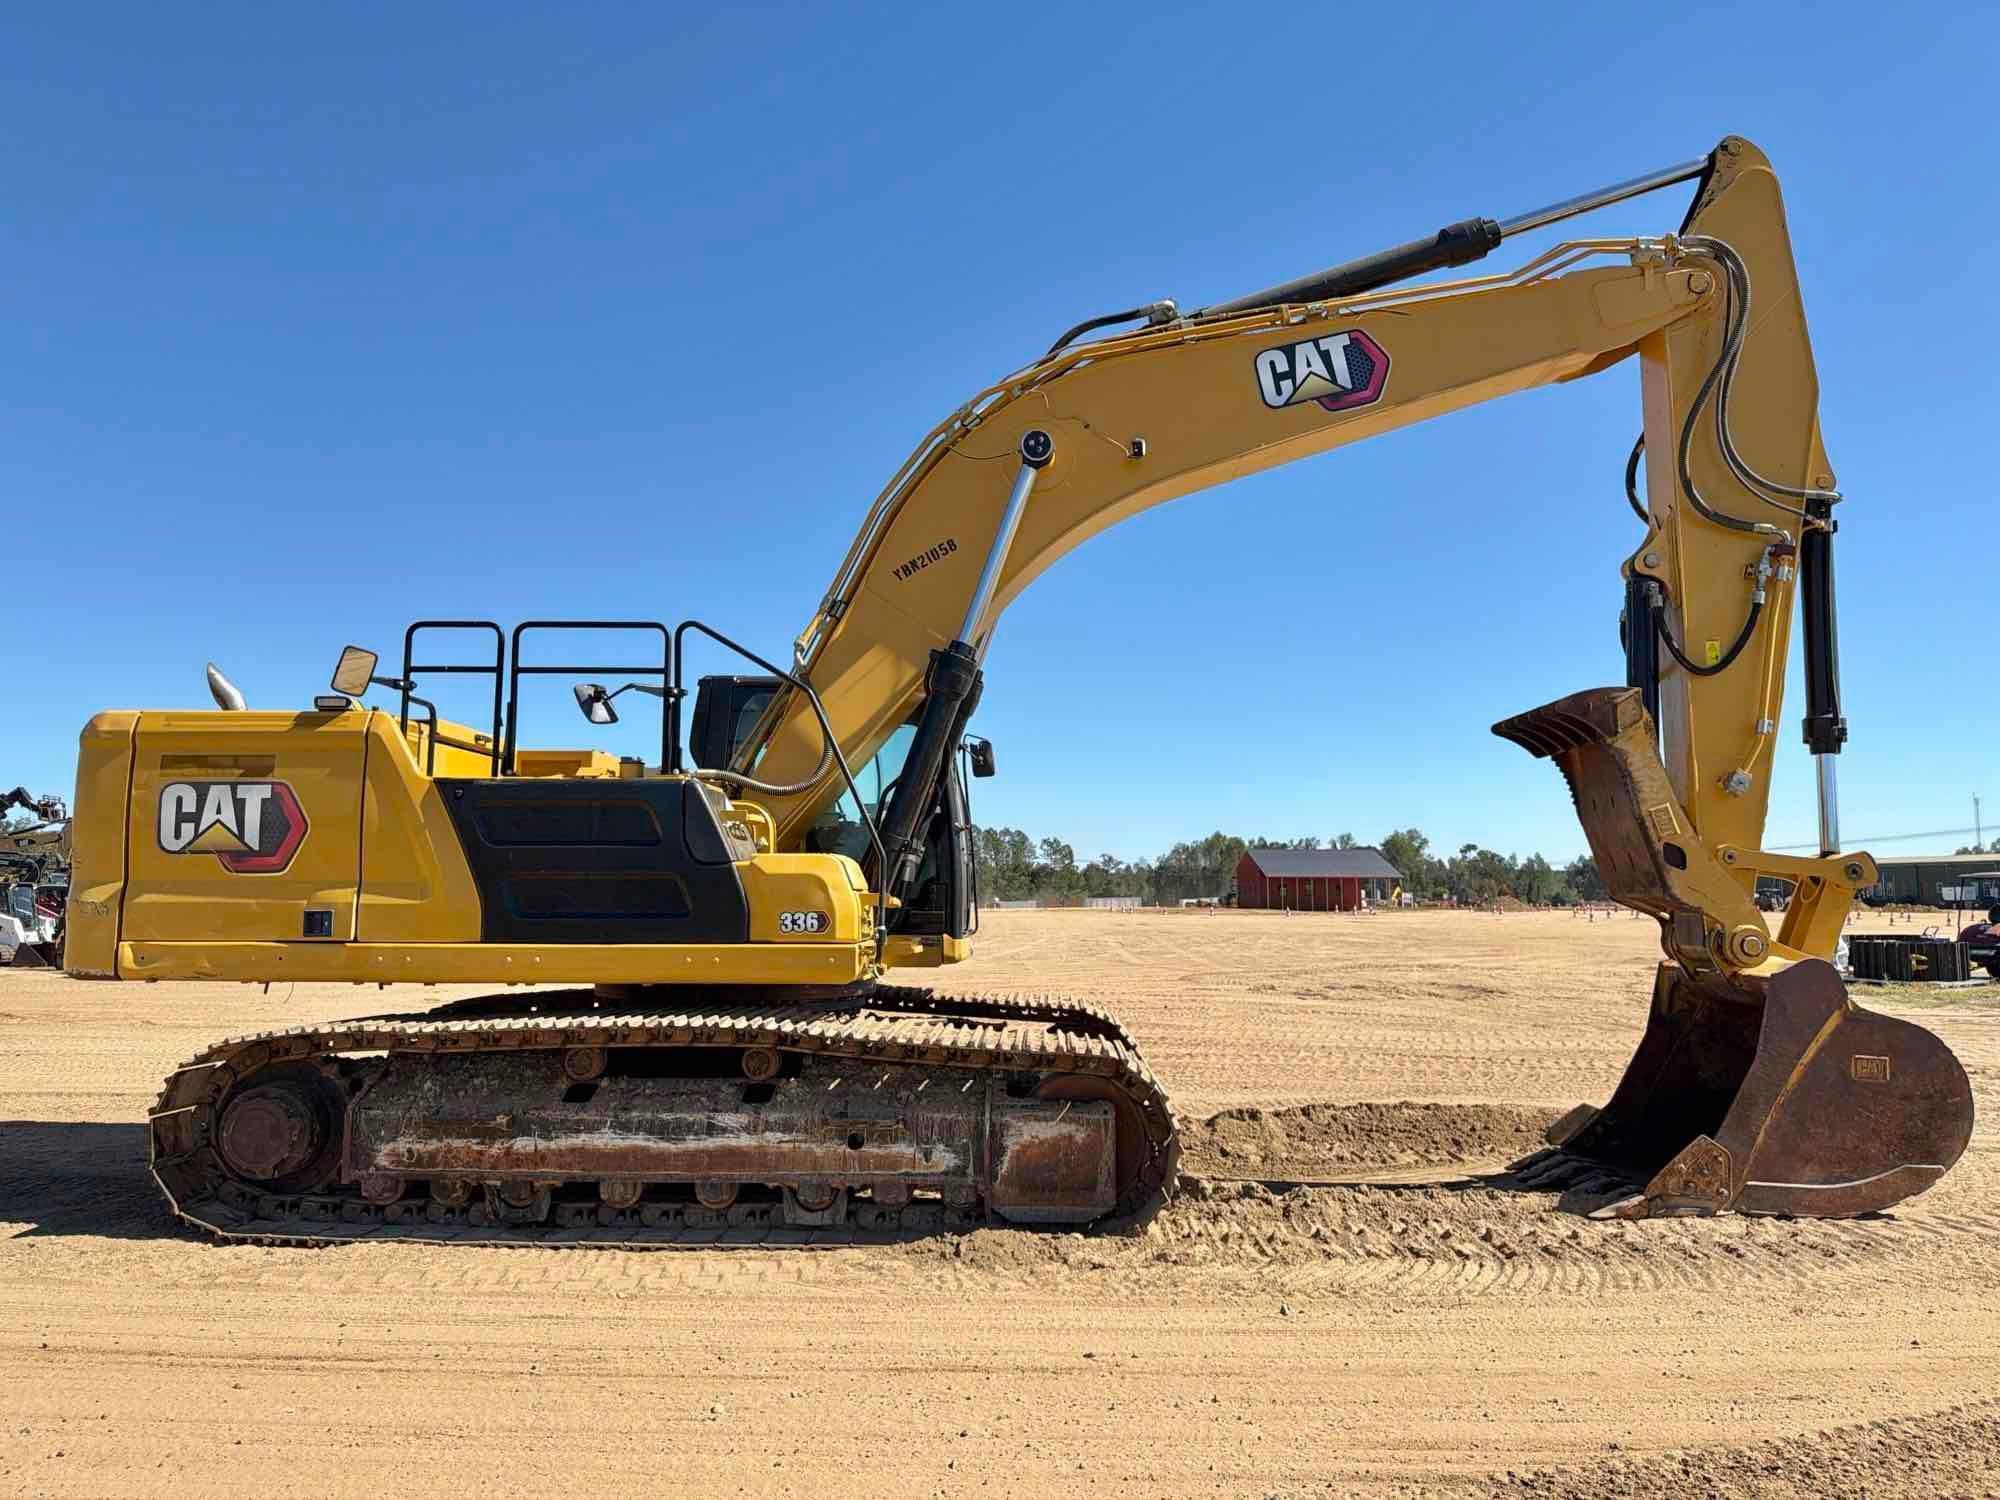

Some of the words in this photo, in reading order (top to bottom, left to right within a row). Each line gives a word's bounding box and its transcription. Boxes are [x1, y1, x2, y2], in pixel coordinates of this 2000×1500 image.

[1256, 333, 1353, 407] CAT
[160, 783, 272, 851] CAT
[780, 911, 818, 932] 336
